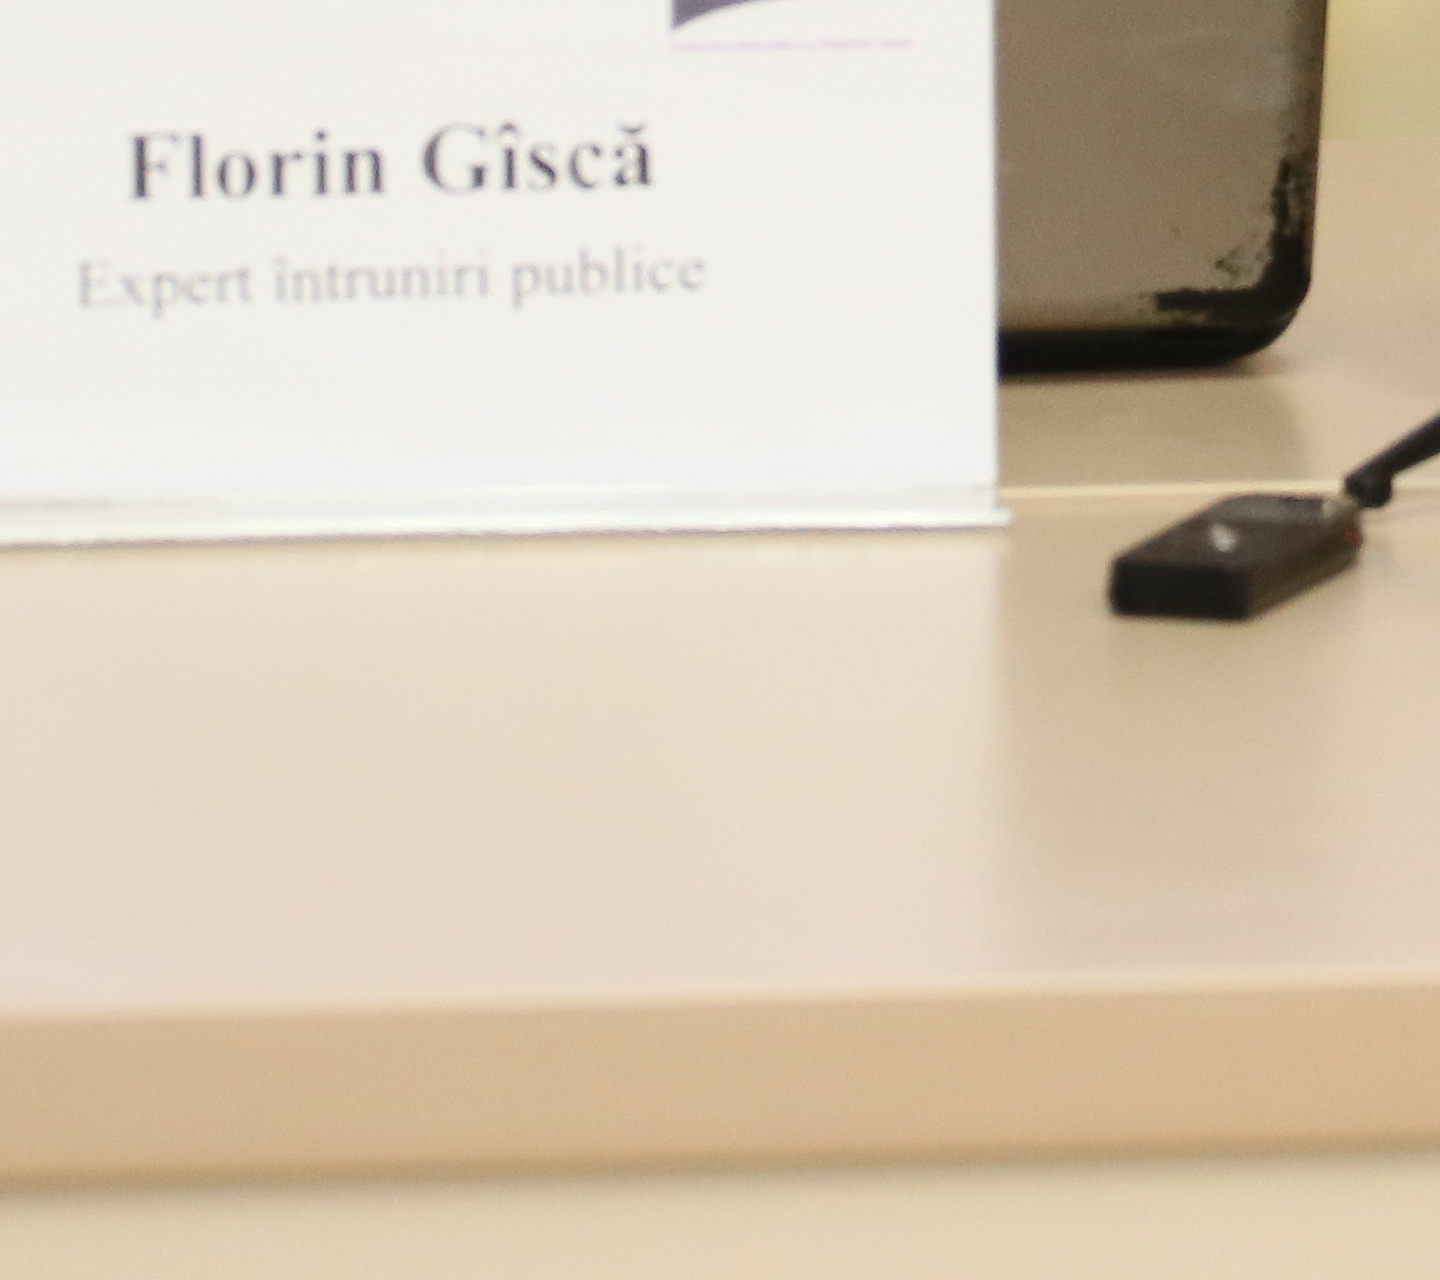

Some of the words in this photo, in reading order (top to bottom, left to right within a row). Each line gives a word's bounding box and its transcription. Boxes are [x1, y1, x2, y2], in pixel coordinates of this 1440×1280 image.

[126, 130, 386, 200] Florin
[421, 122, 654, 193] Gîscă
[77, 258, 252, 320] Expert
[273, 250, 491, 305] întruniri
[510, 244, 707, 311] publice
